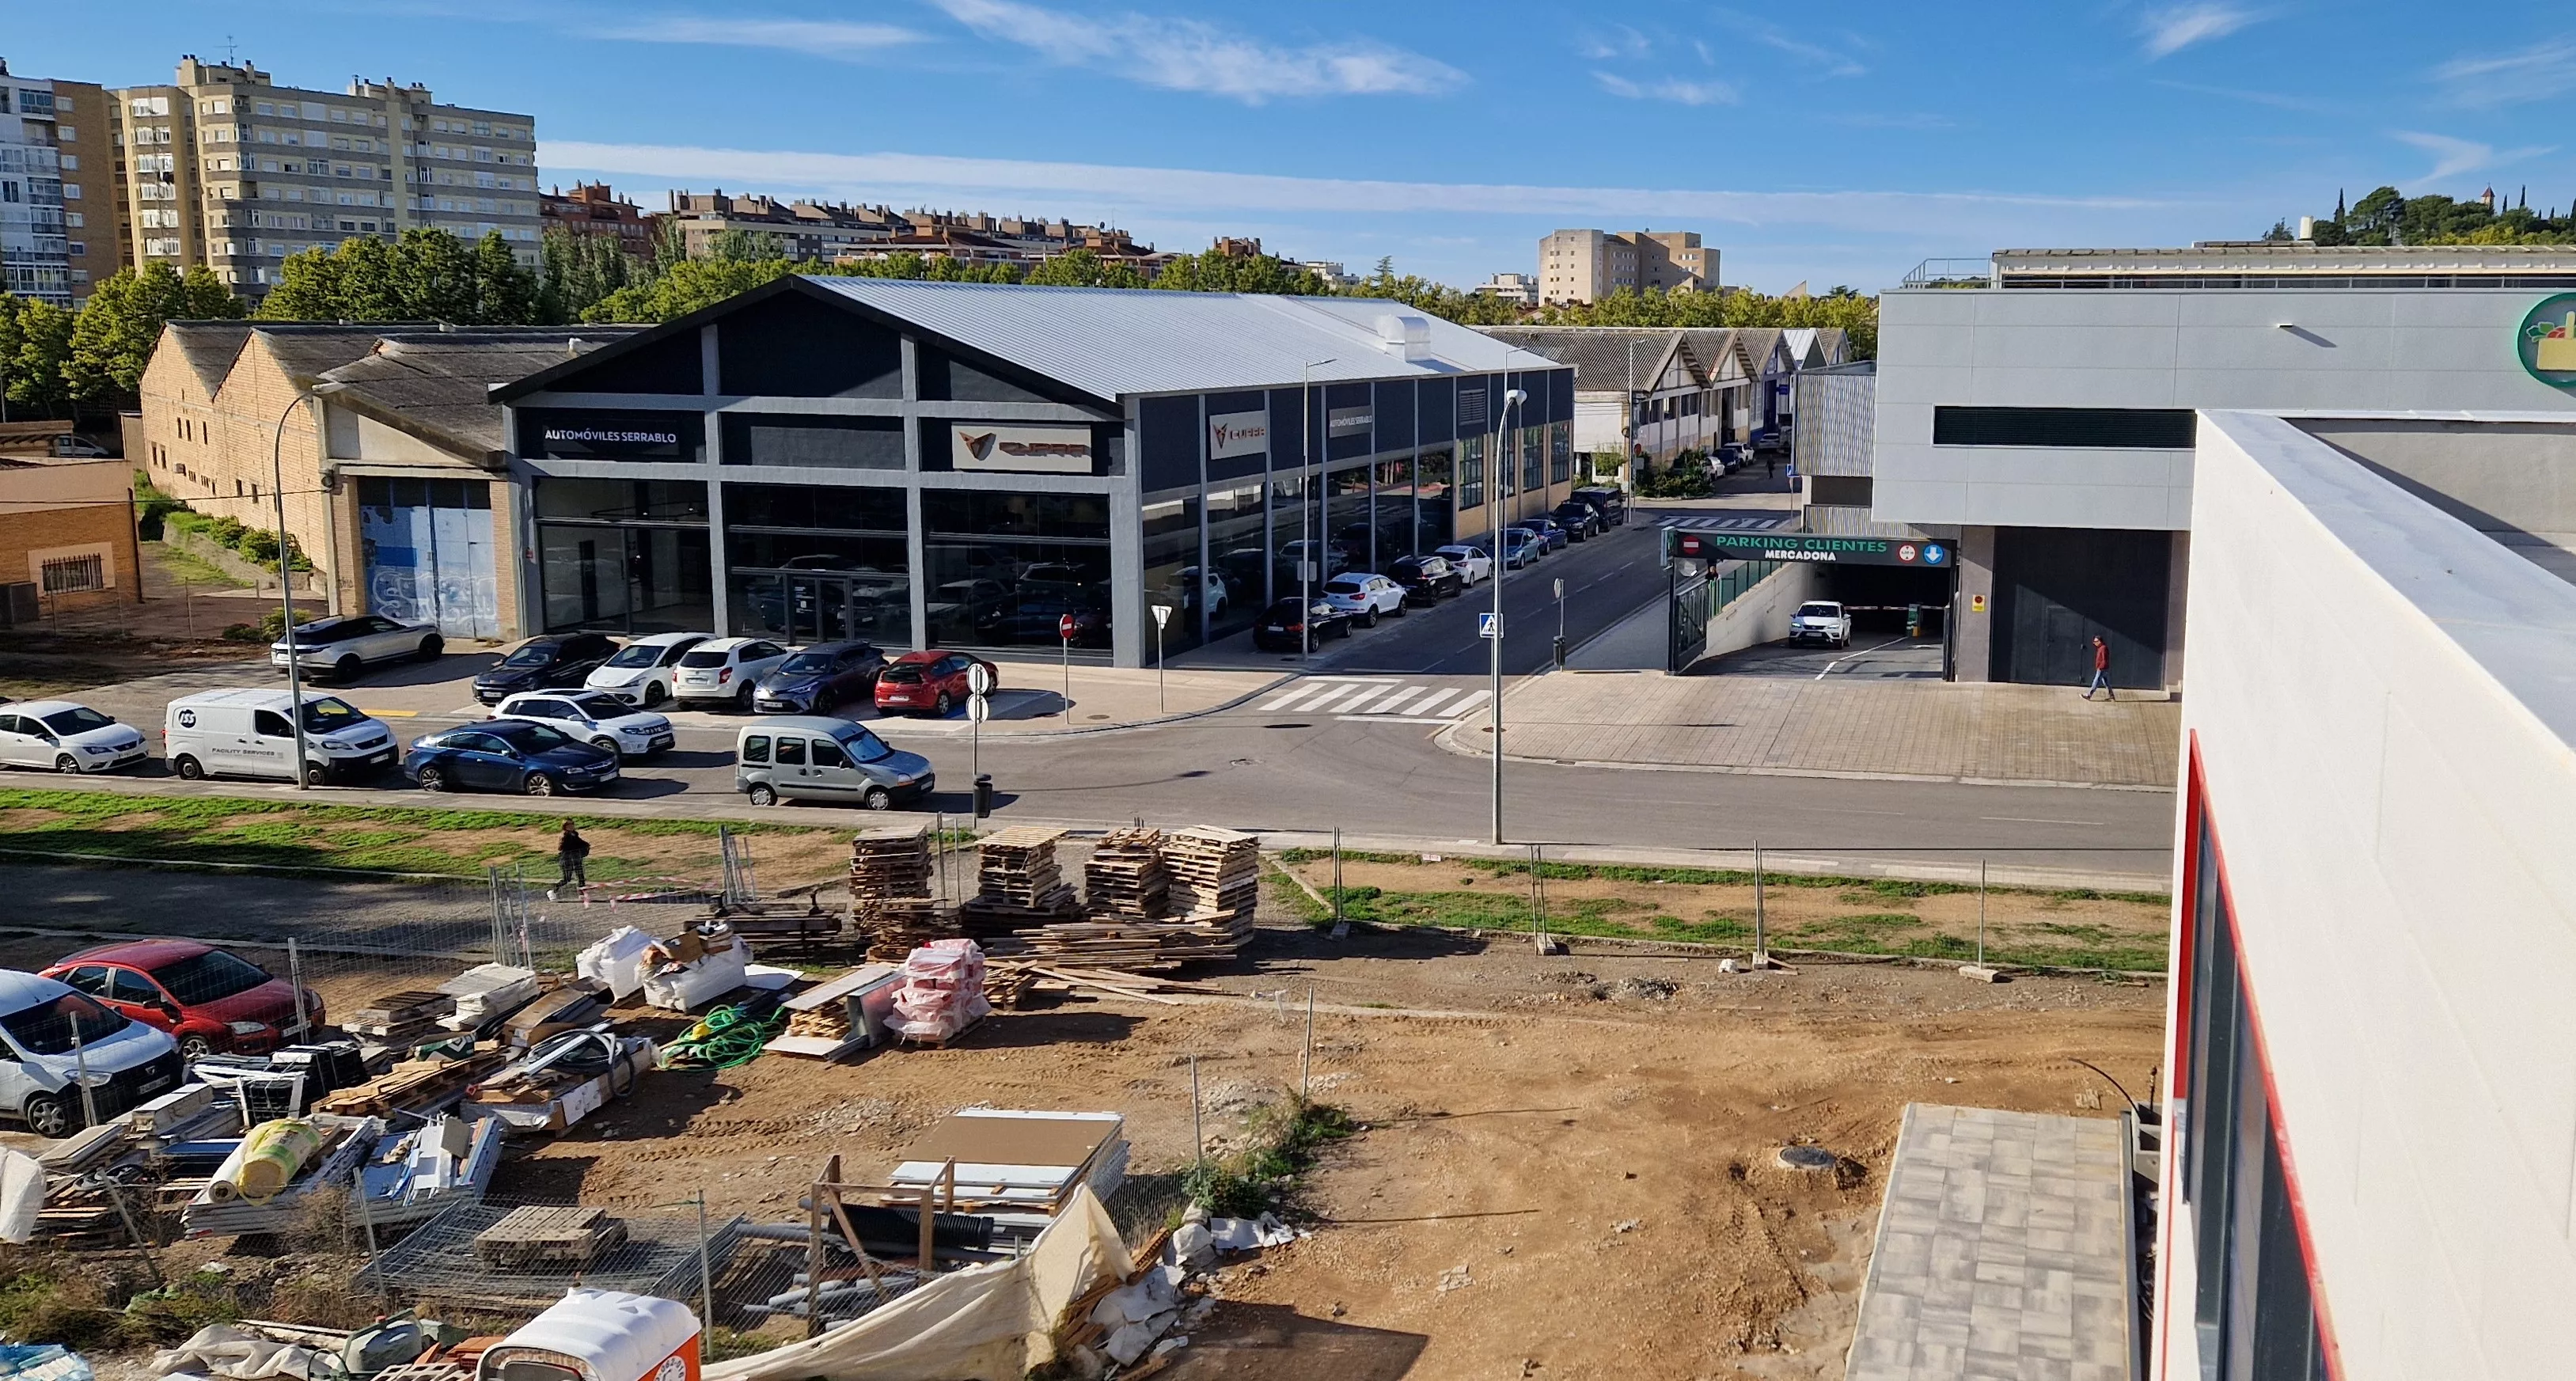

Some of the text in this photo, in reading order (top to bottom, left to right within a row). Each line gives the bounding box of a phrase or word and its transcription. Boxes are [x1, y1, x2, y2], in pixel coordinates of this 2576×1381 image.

[544, 428, 677, 443] AUTOMÓVILES SERRABLO
[1717, 536, 1887, 552] PARKING CLIENTES
[1765, 549, 1836, 561] MERCADONA
[179, 713, 195, 724] ISS
